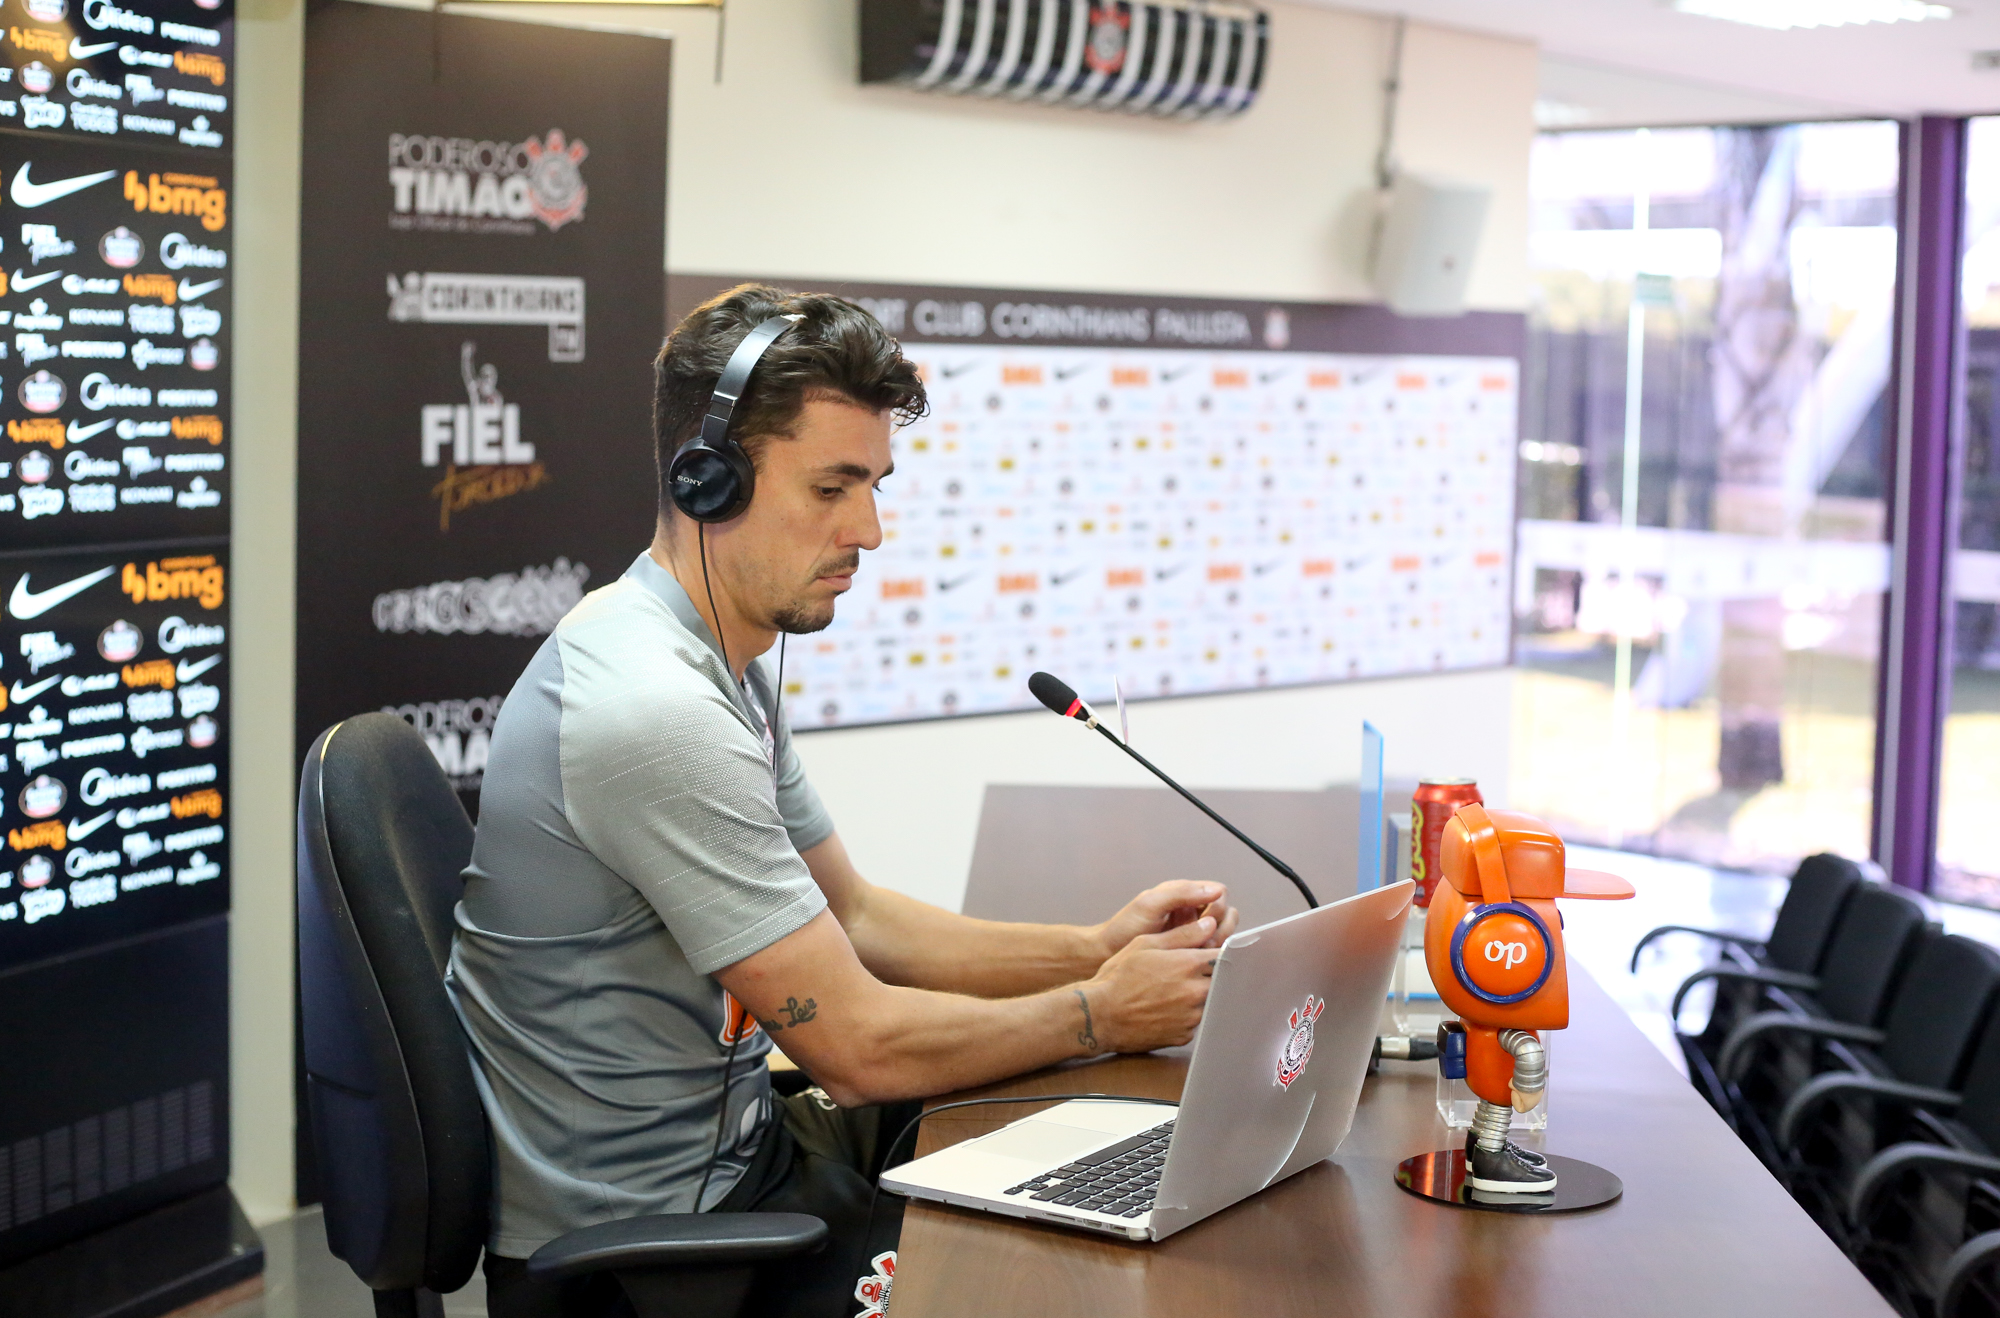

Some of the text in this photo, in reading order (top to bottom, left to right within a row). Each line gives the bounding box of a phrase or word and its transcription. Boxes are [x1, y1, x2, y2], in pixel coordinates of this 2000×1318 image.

[388, 133, 535, 174] PODEROSO
[149, 172, 227, 232] bmg
[912, 298, 987, 337] CLUB
[991, 301, 1151, 342] CORINTHIANS
[420, 402, 536, 467] FIEL
[677, 475, 703, 487] SONY
[146, 560, 224, 610] bmg
[1484, 939, 1528, 970] op
